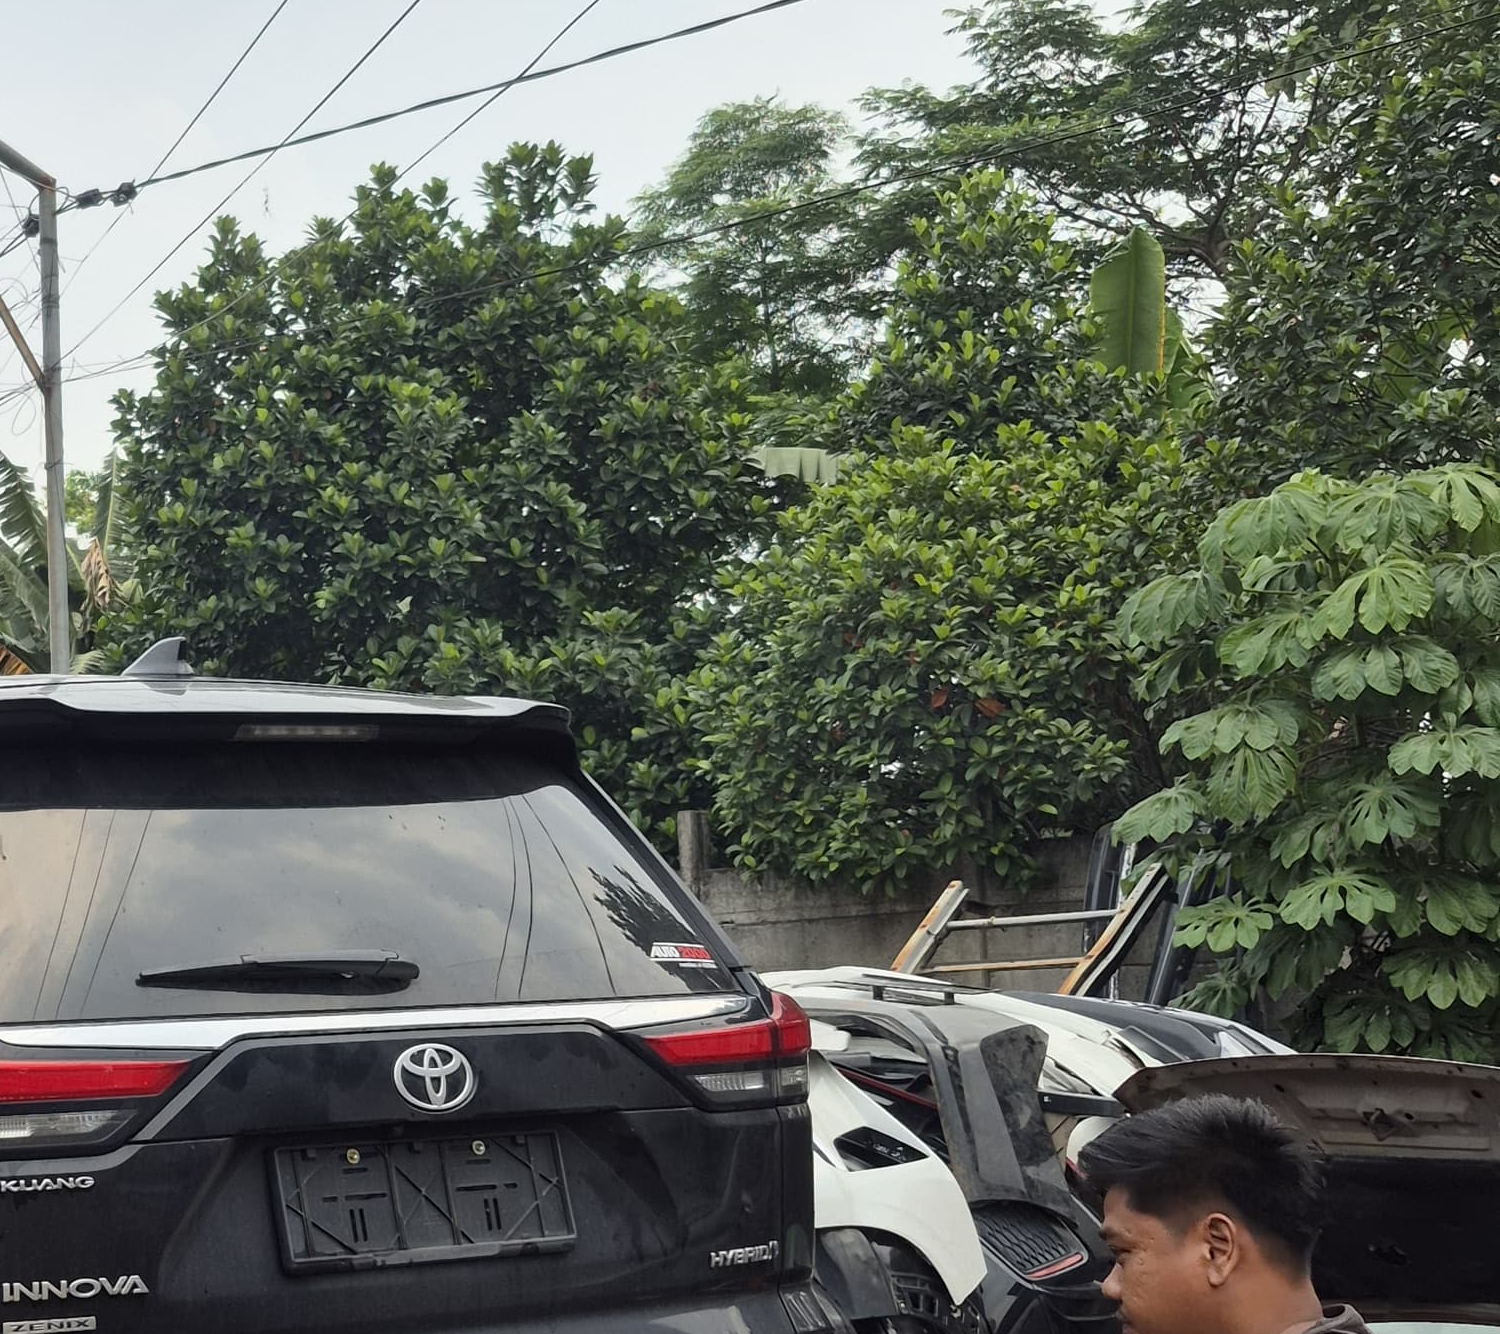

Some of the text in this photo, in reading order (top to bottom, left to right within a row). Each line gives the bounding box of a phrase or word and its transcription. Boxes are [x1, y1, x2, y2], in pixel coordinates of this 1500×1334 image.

[0, 1176, 95, 1192] KUANG
[710, 1245, 769, 1268] HYBRID
[2, 1275, 150, 1303] INNOVA
[10, 1319, 91, 1333] ZENIX
